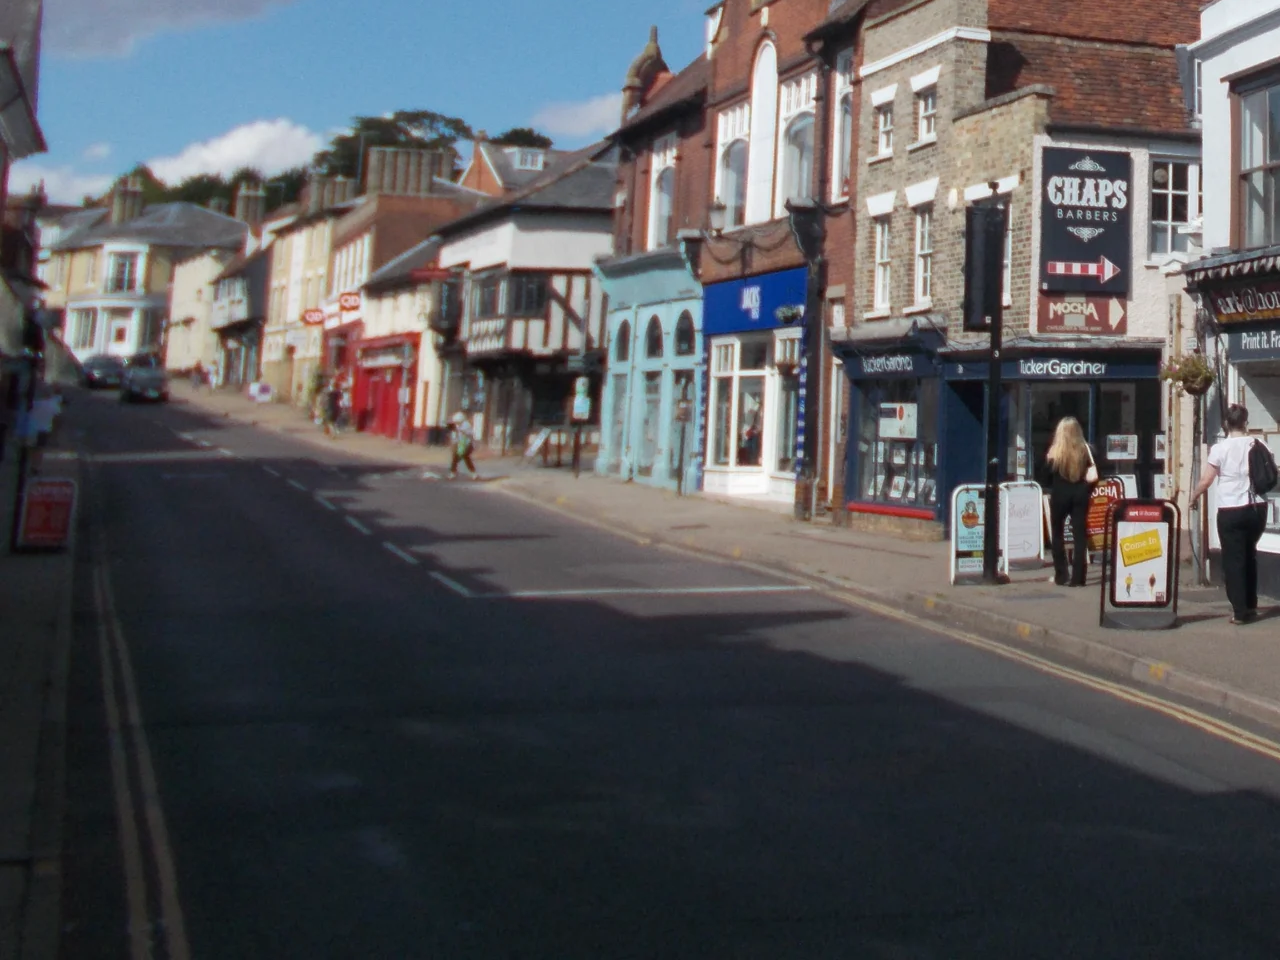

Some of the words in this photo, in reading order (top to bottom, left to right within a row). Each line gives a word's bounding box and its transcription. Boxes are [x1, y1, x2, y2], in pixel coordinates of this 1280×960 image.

[1047, 176, 1127, 209] CHAPS
[1057, 208, 1118, 222] BARBERS
[1049, 302, 1099, 321] MOCHA
[1242, 332, 1260, 349] Print
[1261, 331, 1270, 348] it.
[1019, 358, 1107, 375] TuckerGardner
[1091, 485, 1117, 499] OCHA
[1123, 540, 1147, 551] Come
